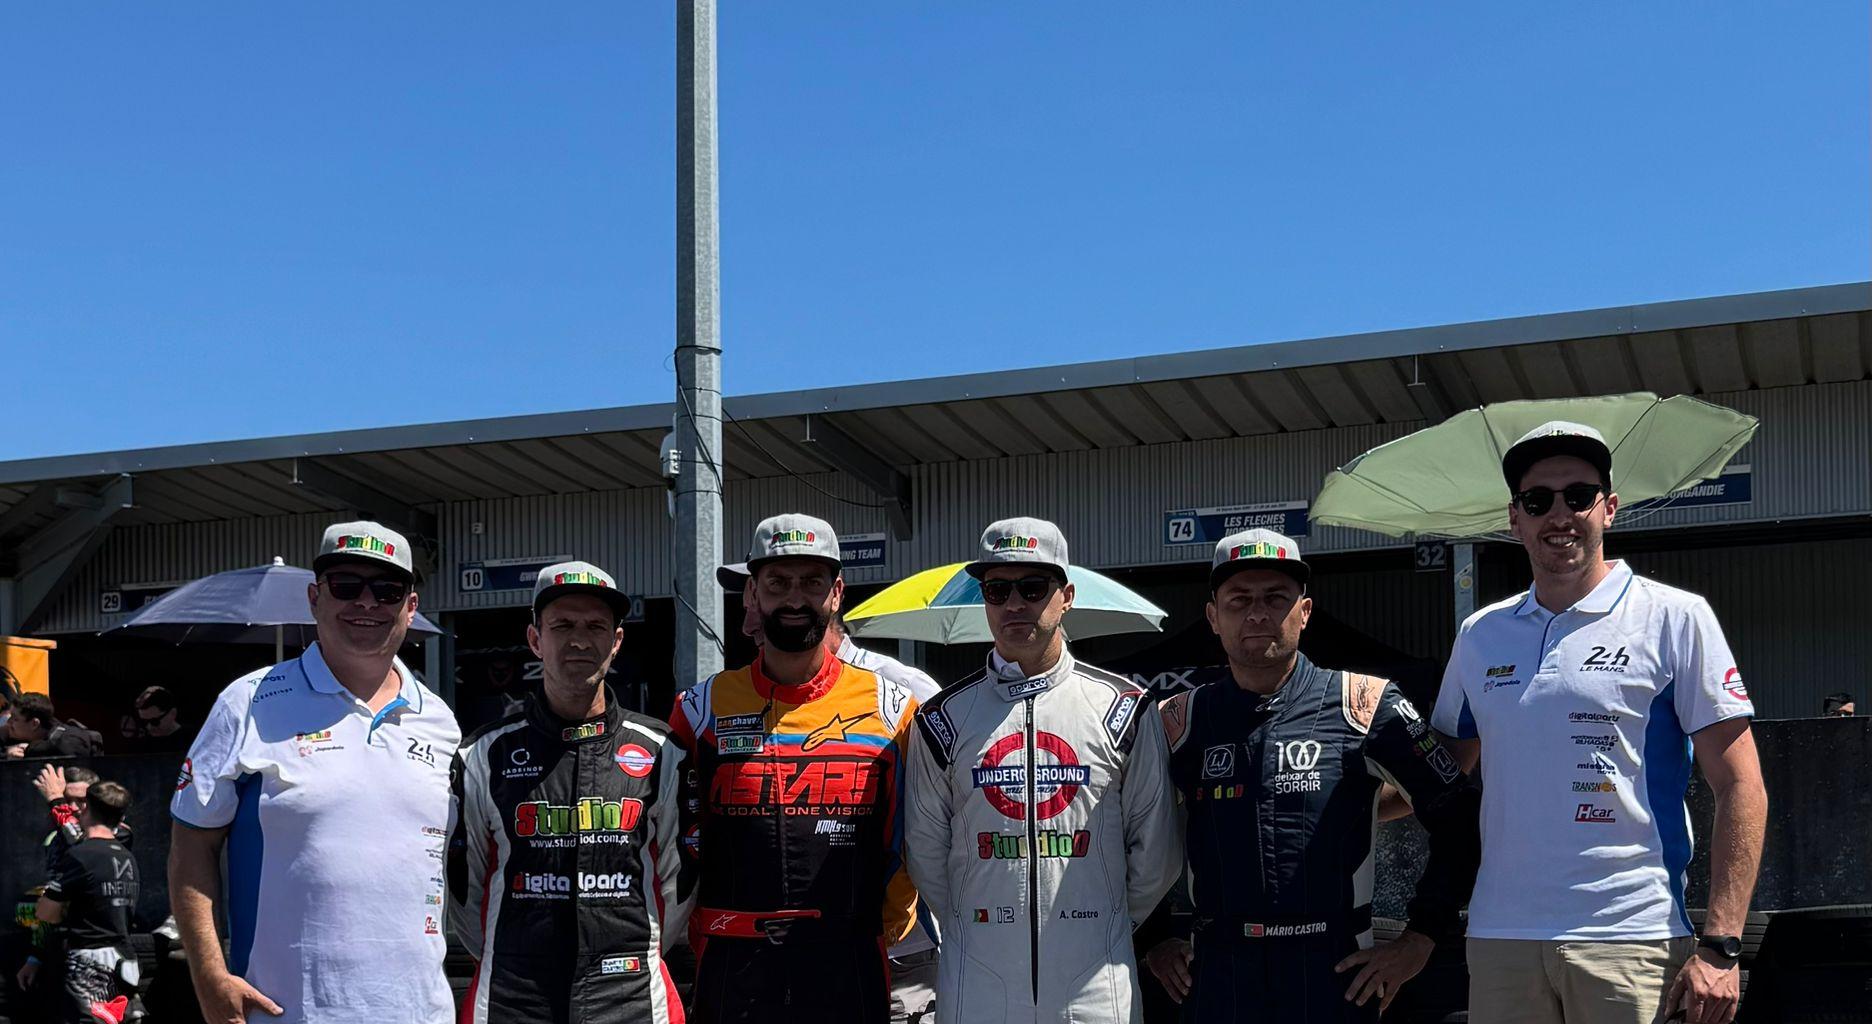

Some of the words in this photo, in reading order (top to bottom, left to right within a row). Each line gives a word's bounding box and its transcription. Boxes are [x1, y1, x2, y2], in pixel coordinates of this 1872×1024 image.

[1224, 516, 1242, 528] LES
[1243, 513, 1286, 526] FLECHES
[1171, 521, 1192, 538] 74
[858, 548, 882, 560] TEAM
[1417, 544, 1445, 567] 32
[464, 571, 481, 588] 10
[103, 594, 119, 610] 29
[1110, 696, 1133, 732] sparco
[978, 768, 1085, 784] UNDERGROUND
[1275, 771, 1305, 782] deixar
[1308, 770, 1321, 780] de
[1275, 780, 1321, 794] SORRIR
[515, 797, 643, 837] StudioD
[727, 806, 771, 816] GOAL
[784, 806, 821, 816] ONE
[825, 806, 874, 816] VISION
[529, 833, 630, 849] www.studiod.com.pt
[978, 829, 1091, 860] StudioD
[513, 871, 632, 893] digitalparts
[996, 906, 1016, 924] 12
[1059, 910, 1069, 920] A.
[1071, 909, 1099, 919] Castro
[1265, 924, 1294, 937] MÁRIO
[1294, 921, 1327, 934] CASTRO
